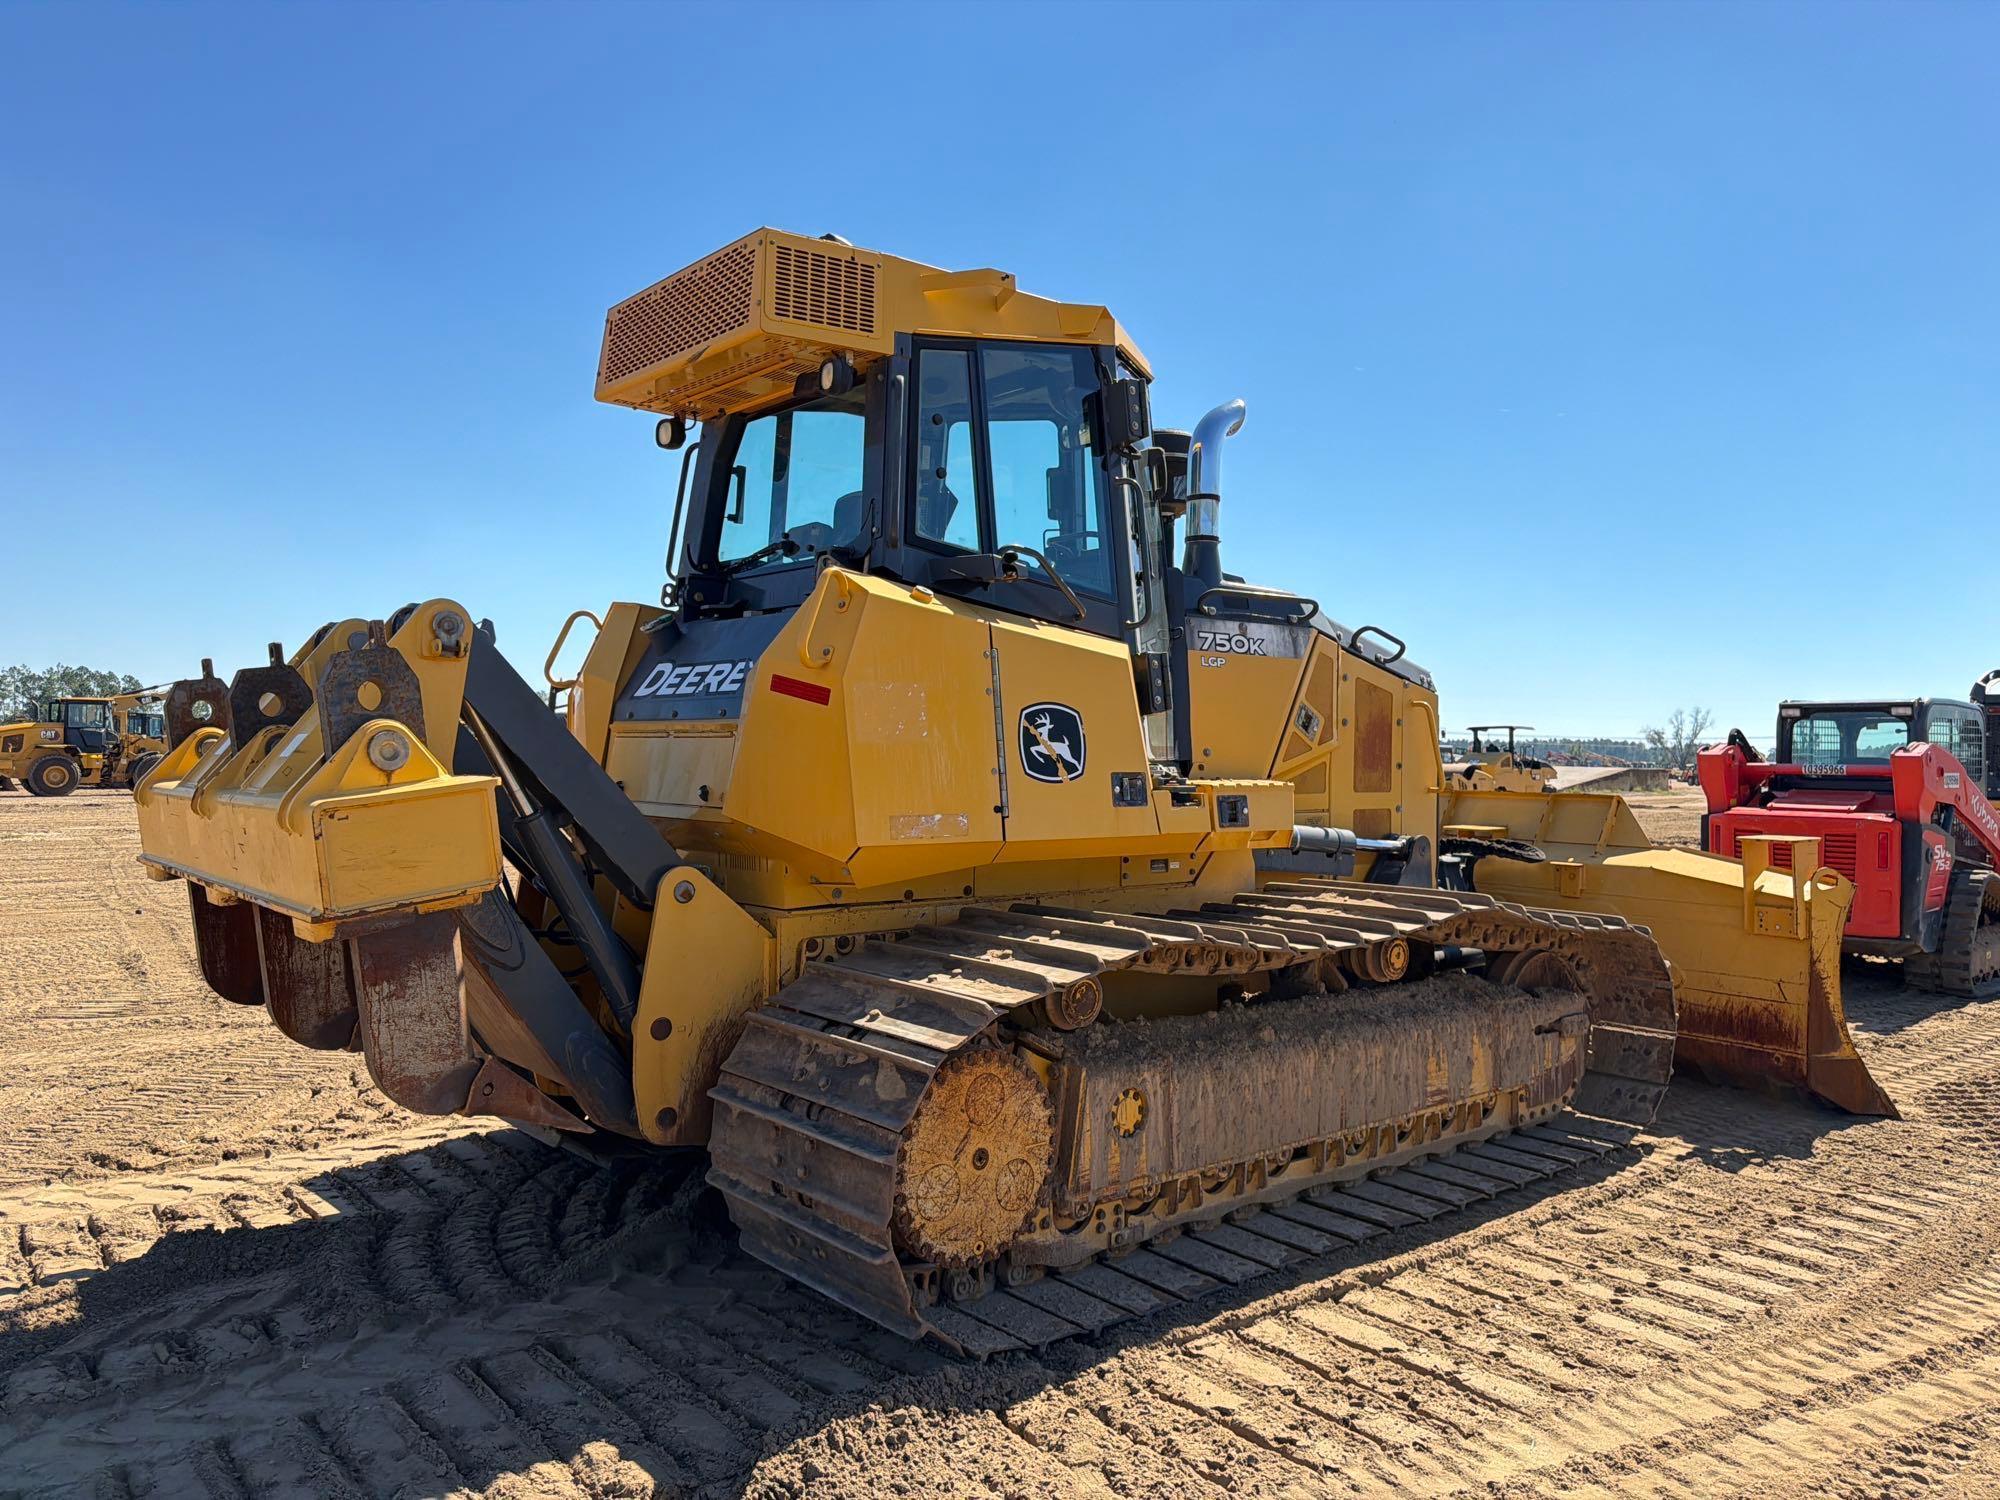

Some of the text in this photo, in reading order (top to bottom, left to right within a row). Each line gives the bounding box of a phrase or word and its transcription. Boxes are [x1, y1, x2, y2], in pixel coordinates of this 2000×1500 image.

[1198, 631, 1266, 656] 750K
[1201, 656, 1226, 667] LGP
[633, 661, 753, 697] DEERE
[41, 730, 55, 739] CAT
[1803, 764, 1844, 774] 10395966
[1972, 795, 1998, 837] Kubota
